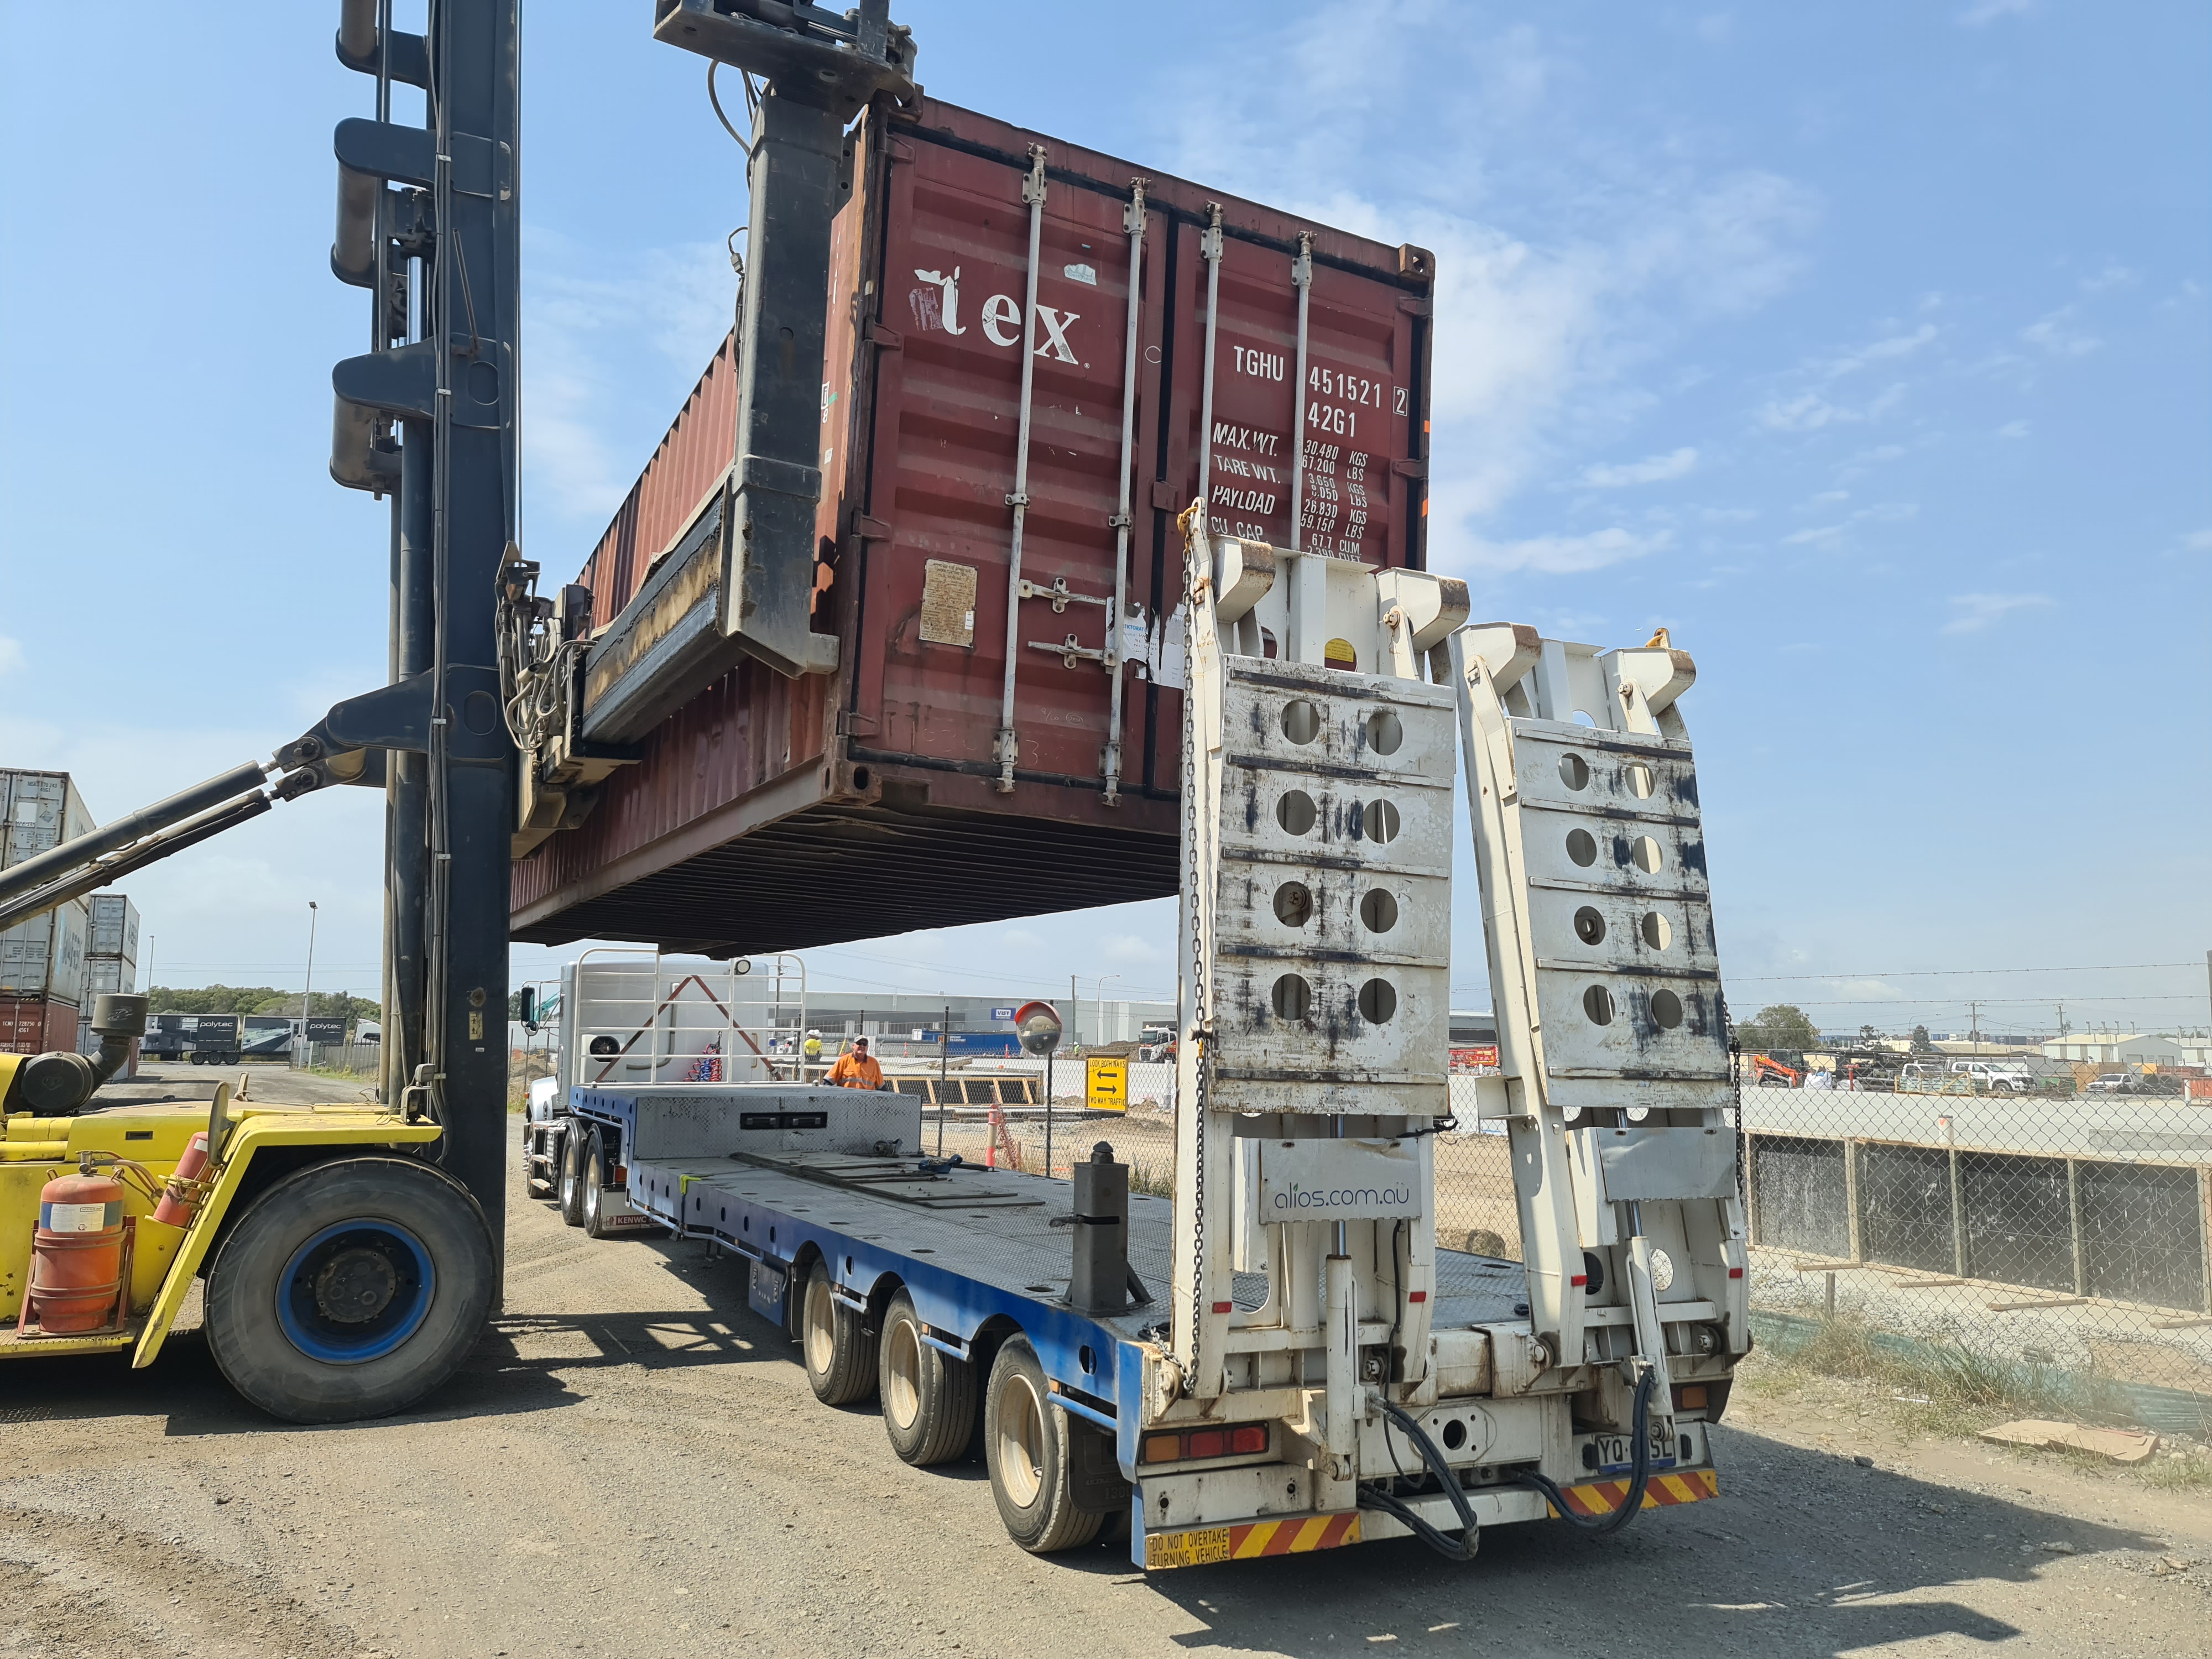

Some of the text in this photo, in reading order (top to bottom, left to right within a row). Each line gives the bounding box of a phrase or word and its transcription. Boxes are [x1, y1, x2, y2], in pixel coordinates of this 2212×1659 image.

[1233, 345, 1406, 414] TGHU 451521 2
[1308, 401, 1355, 437] 42G1
[1349, 450, 1368, 467] KGS
[1213, 454, 1251, 478] TARE
[1251, 462, 1281, 484] WT.
[1347, 482, 1365, 496] KGS
[1347, 467, 1364, 482] LBS
[1211, 484, 1276, 515] PAYLOAD
[1349, 508, 1368, 525] KGS
[1350, 495, 1368, 508] LBS
[1345, 523, 1365, 539] LBS
[1311, 533, 1333, 550] 67.7
[200, 1020, 233, 1029] polytec
[310, 1022, 341, 1030] polytec
[1113, 1060, 1125, 1068] WAYS
[1098, 1097, 1107, 1105] WAY
[1274, 1182, 1409, 1209] alios.com.au
[1152, 1528, 1227, 1551] DO NOT OVERTAKE
[1152, 1545, 1228, 1567] TURNING VEHICLE
